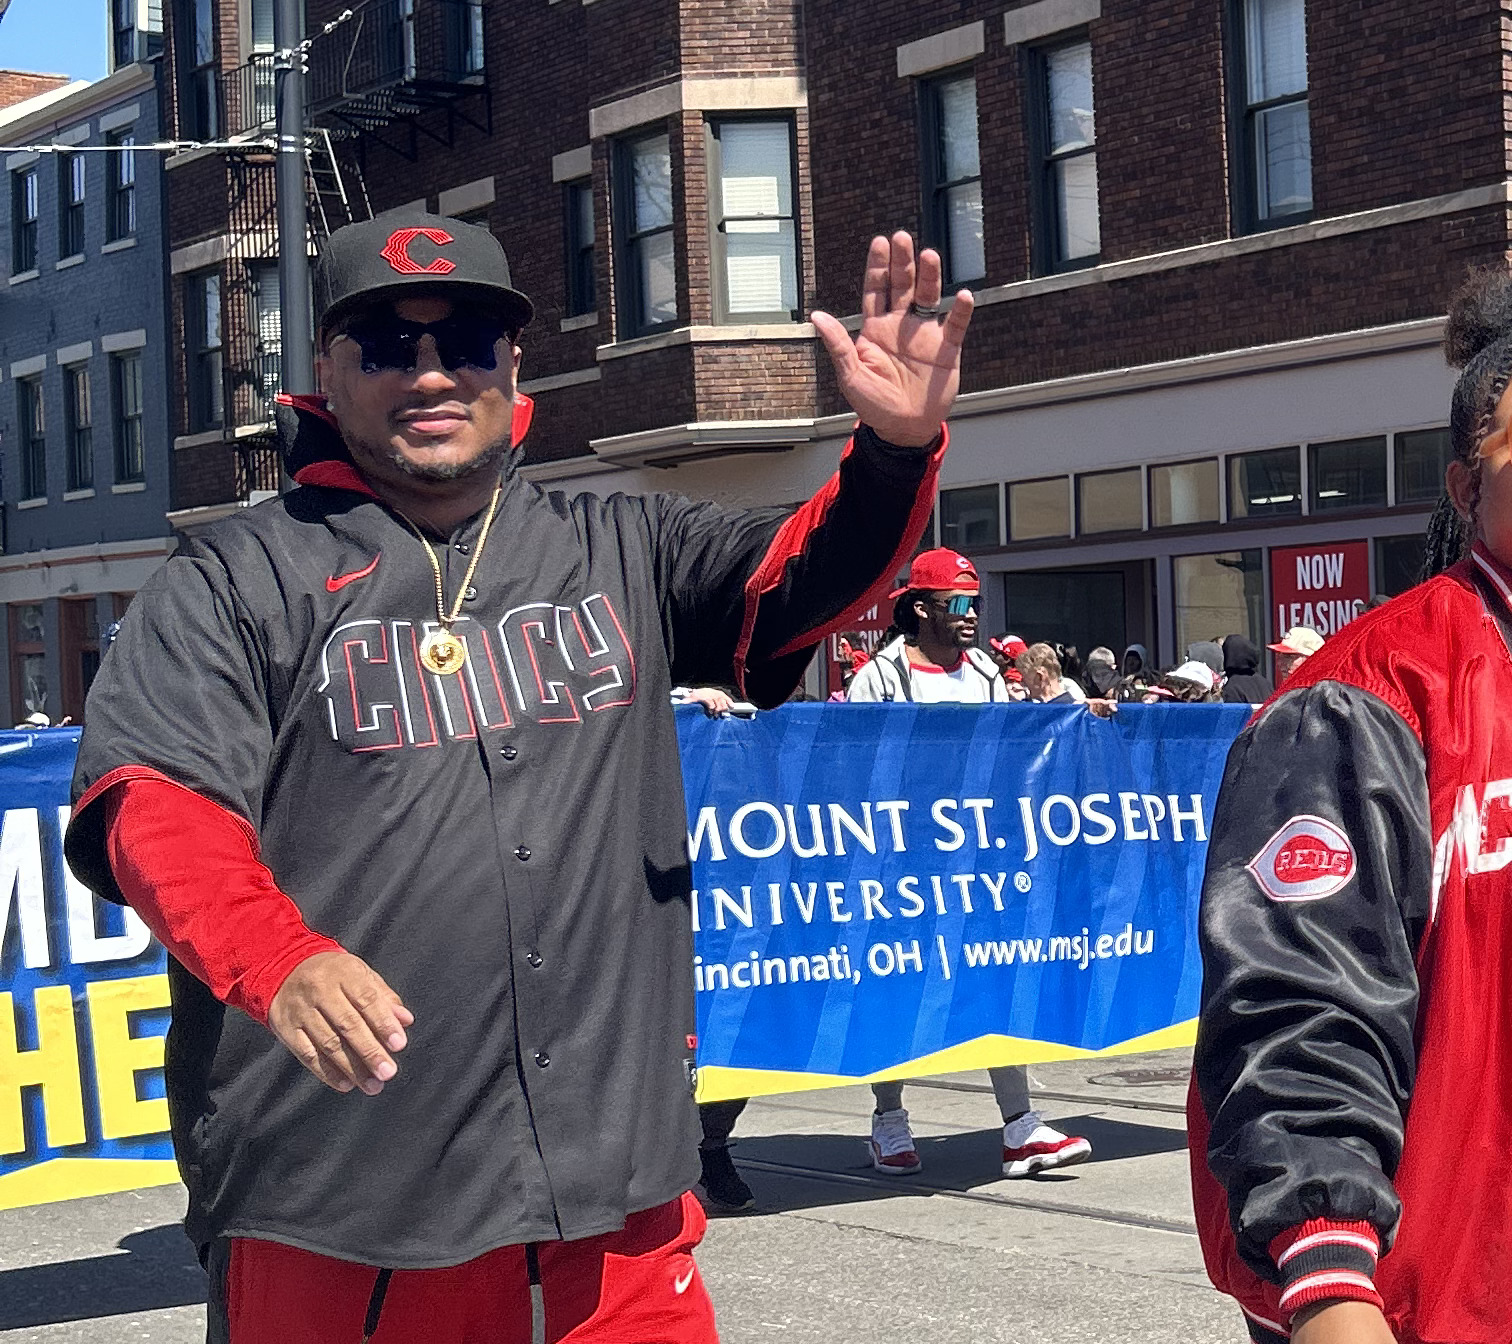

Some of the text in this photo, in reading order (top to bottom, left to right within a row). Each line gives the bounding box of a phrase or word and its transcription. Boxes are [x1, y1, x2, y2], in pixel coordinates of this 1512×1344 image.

[1296, 553, 1344, 591] NOW
[688, 791, 1208, 862] MOUNT ST. JOSEPH
[867, 939, 923, 977] OH
[963, 922, 1154, 971] www.msj.edu
